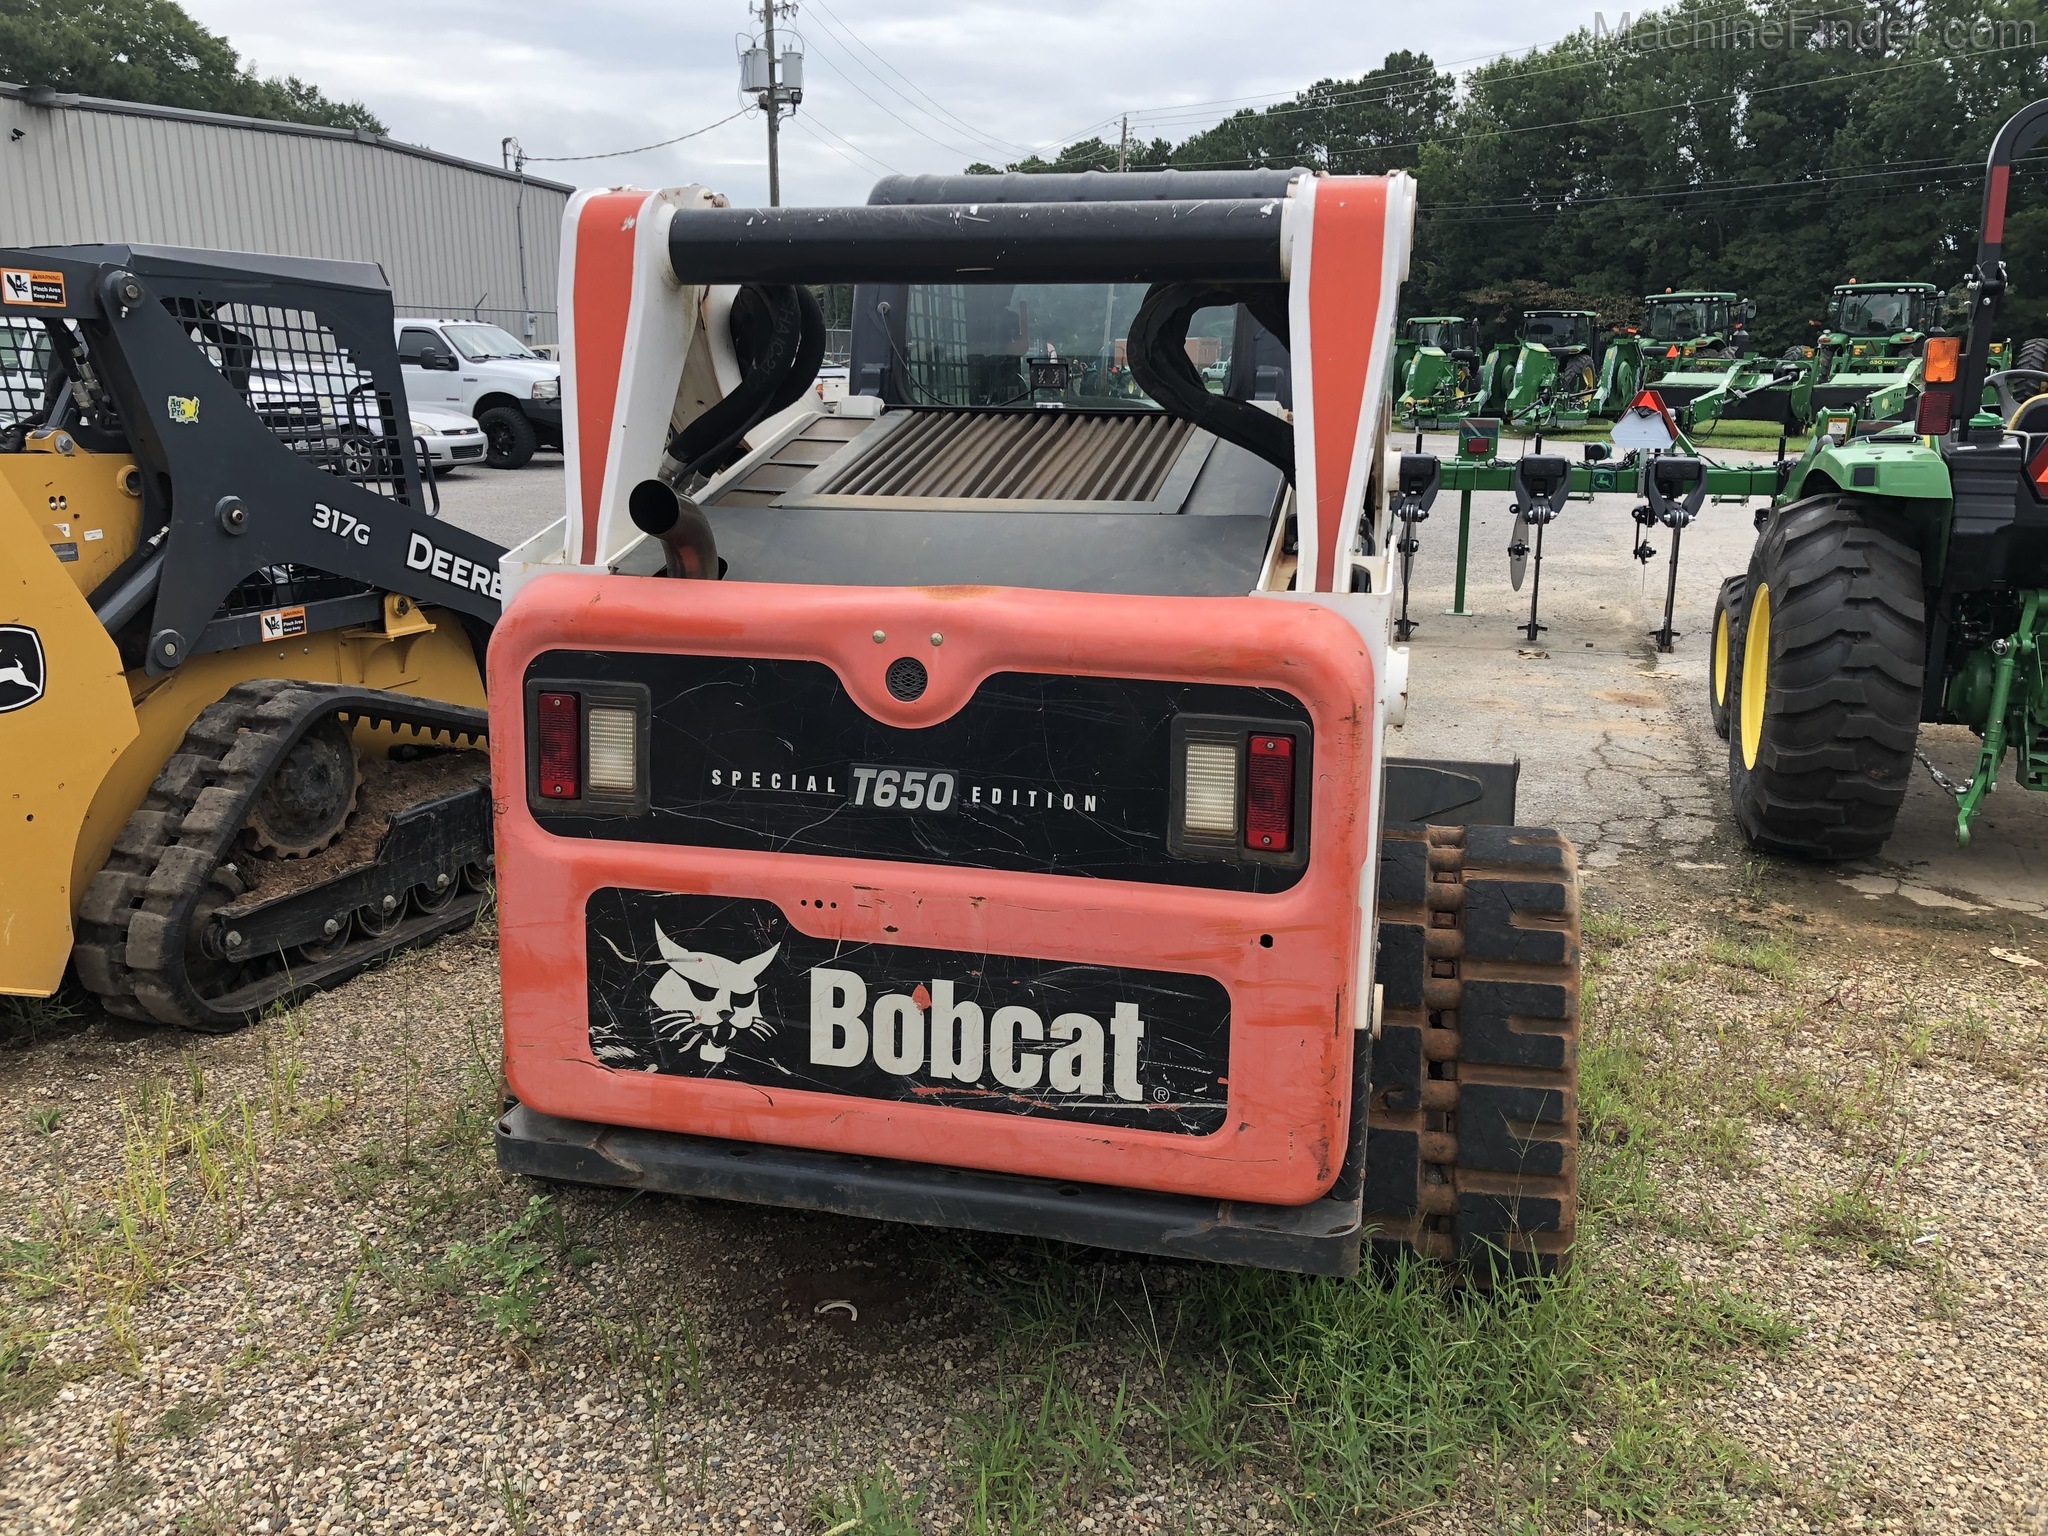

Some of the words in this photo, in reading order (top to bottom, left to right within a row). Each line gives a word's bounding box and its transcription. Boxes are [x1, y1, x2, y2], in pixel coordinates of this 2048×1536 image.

[171, 408, 186, 416] Pro
[312, 503, 371, 546] 317G
[711, 769, 836, 793] SPECIAL
[852, 767, 956, 812] T650
[971, 786, 1097, 812] EDITION
[809, 967, 1145, 1102] Bobcat
